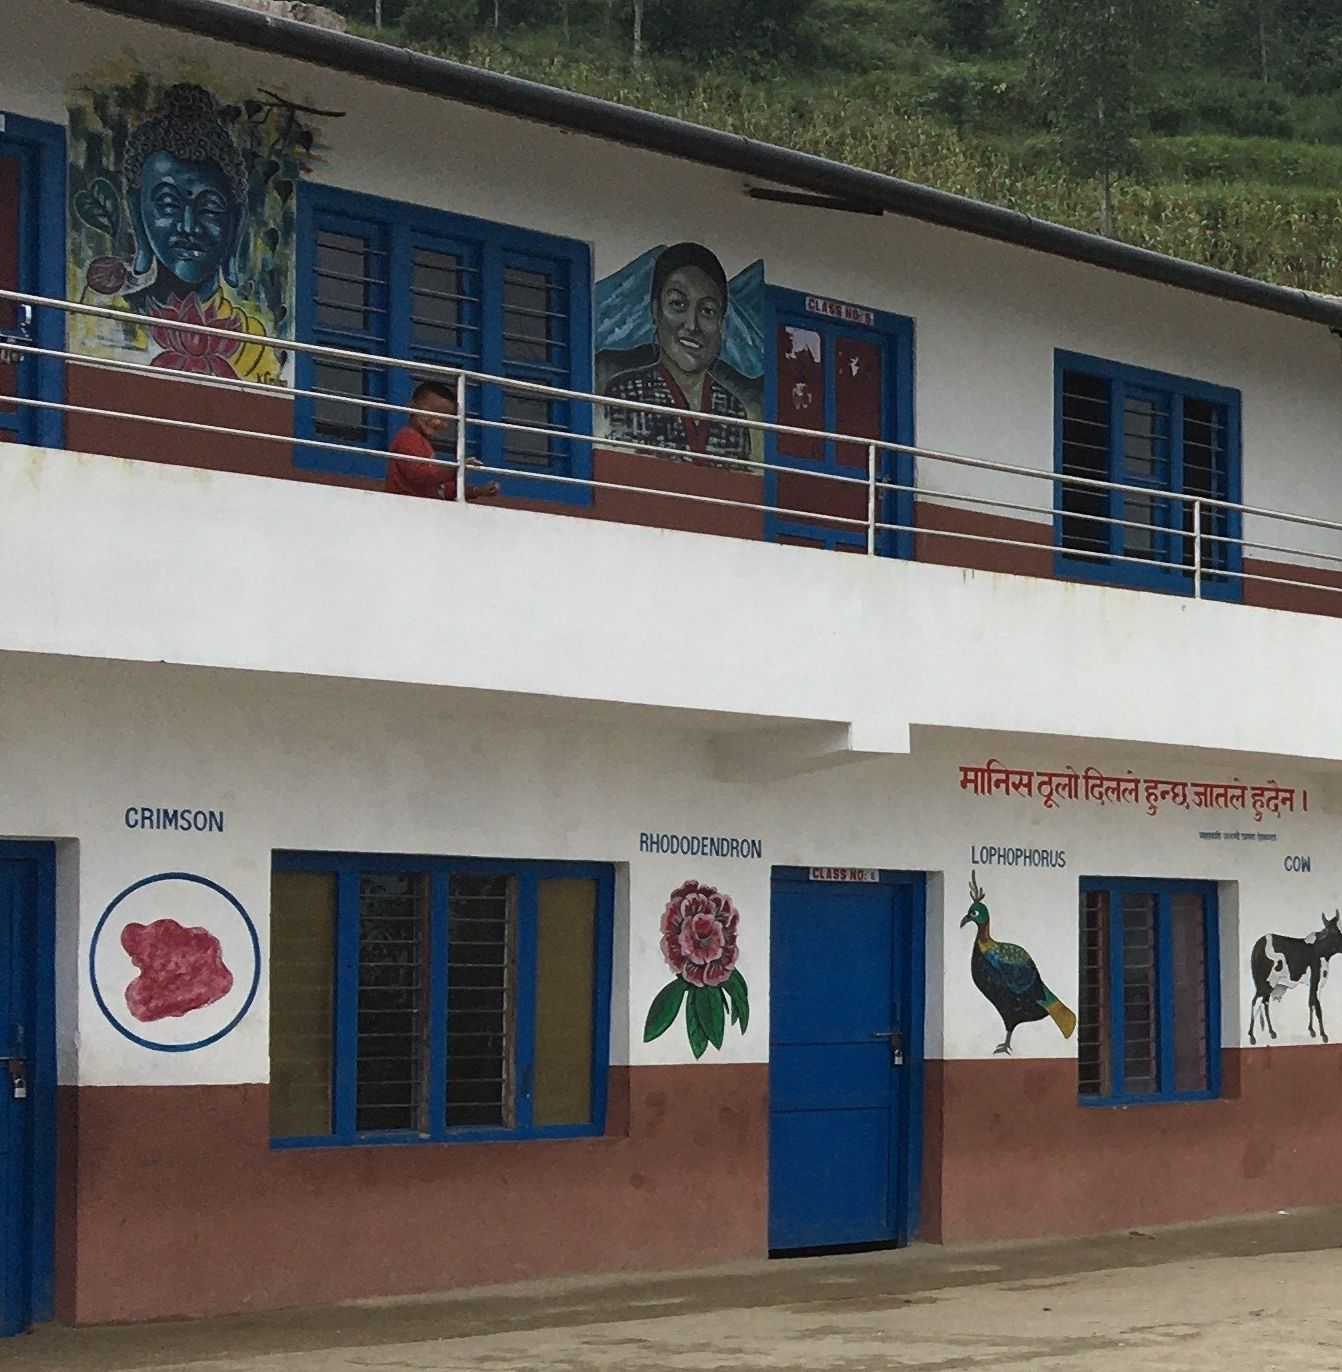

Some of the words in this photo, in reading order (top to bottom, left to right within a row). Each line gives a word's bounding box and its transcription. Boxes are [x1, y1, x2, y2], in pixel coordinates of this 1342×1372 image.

[808, 298, 842, 317] CLASS
[959, 759, 1034, 798] मानिस
[1036, 765, 1080, 808] ठूलो
[1082, 767, 1141, 804] दिलले
[1190, 777, 1248, 809] जातले
[125, 807, 224, 832] CRIMSON
[640, 832, 762, 858] RHODODENDRON
[971, 845, 1066, 868] LOPHOPHORUS
[812, 867, 847, 880] CLASS
[1284, 855, 1311, 873] COW
